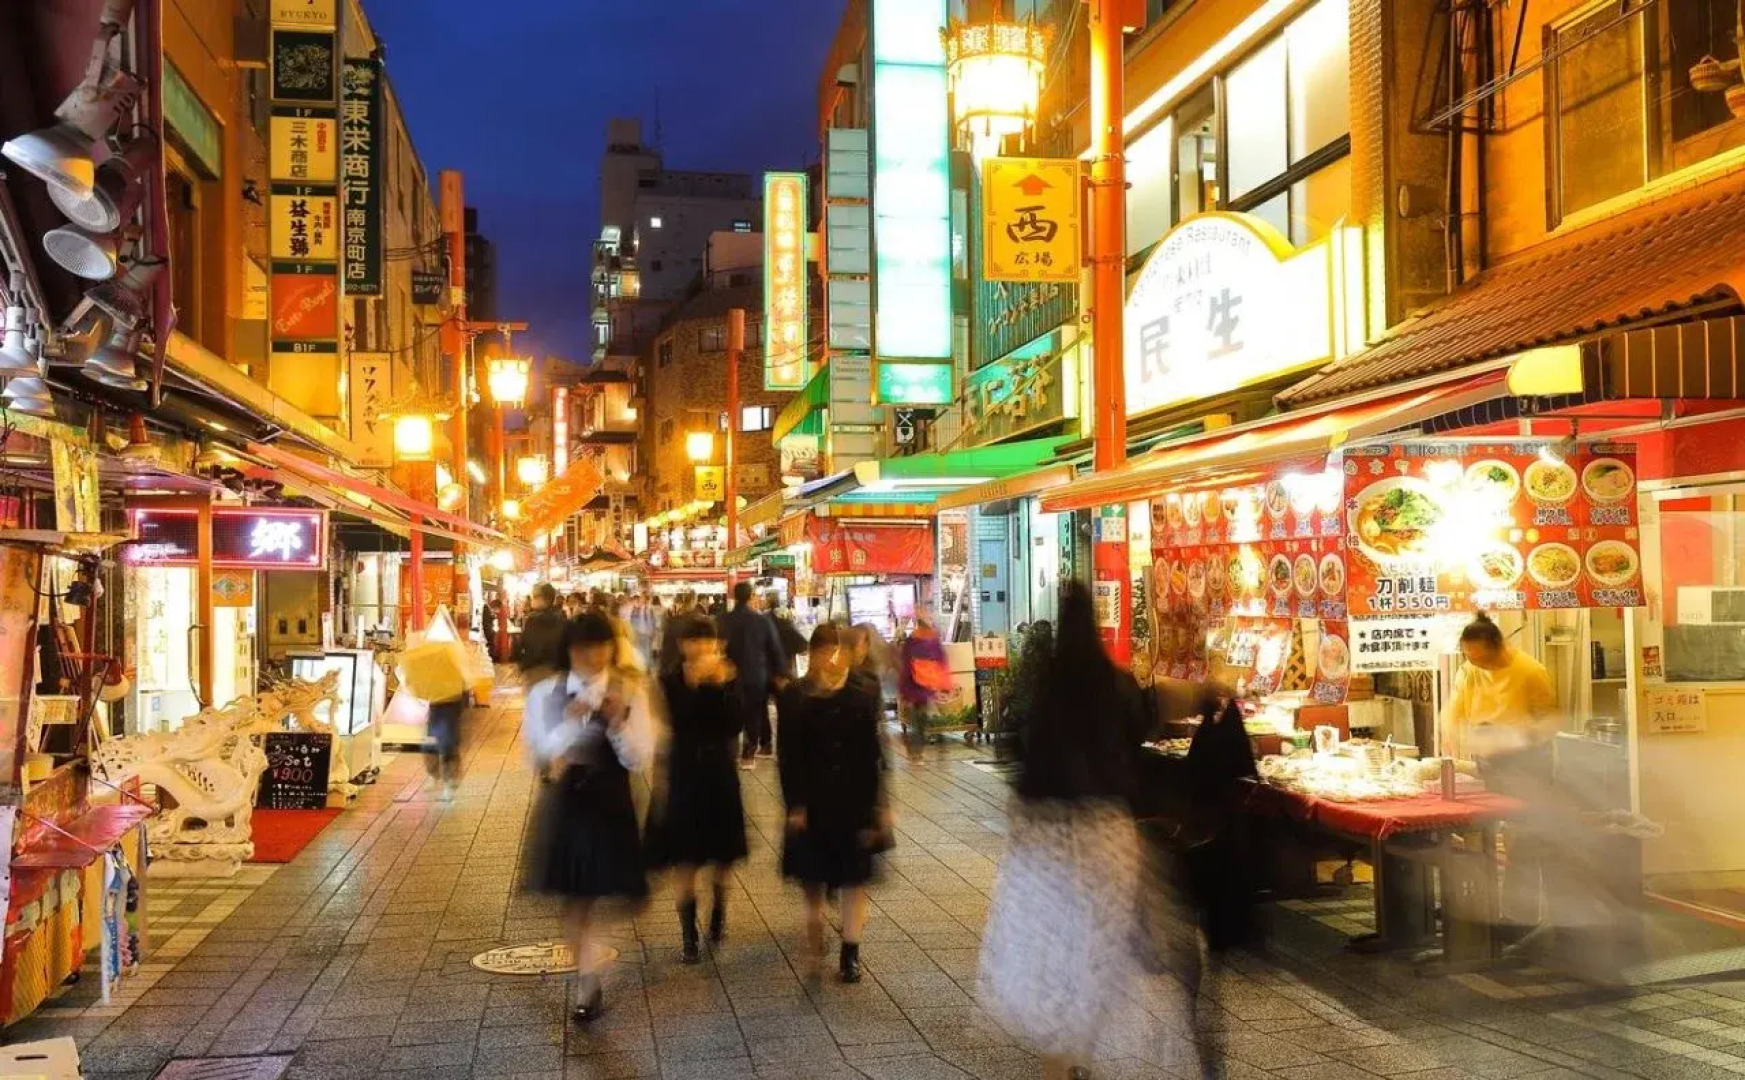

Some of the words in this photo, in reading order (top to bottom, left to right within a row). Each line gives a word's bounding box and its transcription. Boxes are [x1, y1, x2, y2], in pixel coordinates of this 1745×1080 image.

[290, 121, 308, 178] 三木商店
[347, 208, 367, 279] 南京町店
[1006, 205, 1059, 244] 西
[1013, 251, 1053, 267] 広場
[293, 343, 317, 353] B1F
[1140, 287, 1244, 384] 民生
[1359, 640, 1430, 653] お食事頂けます
